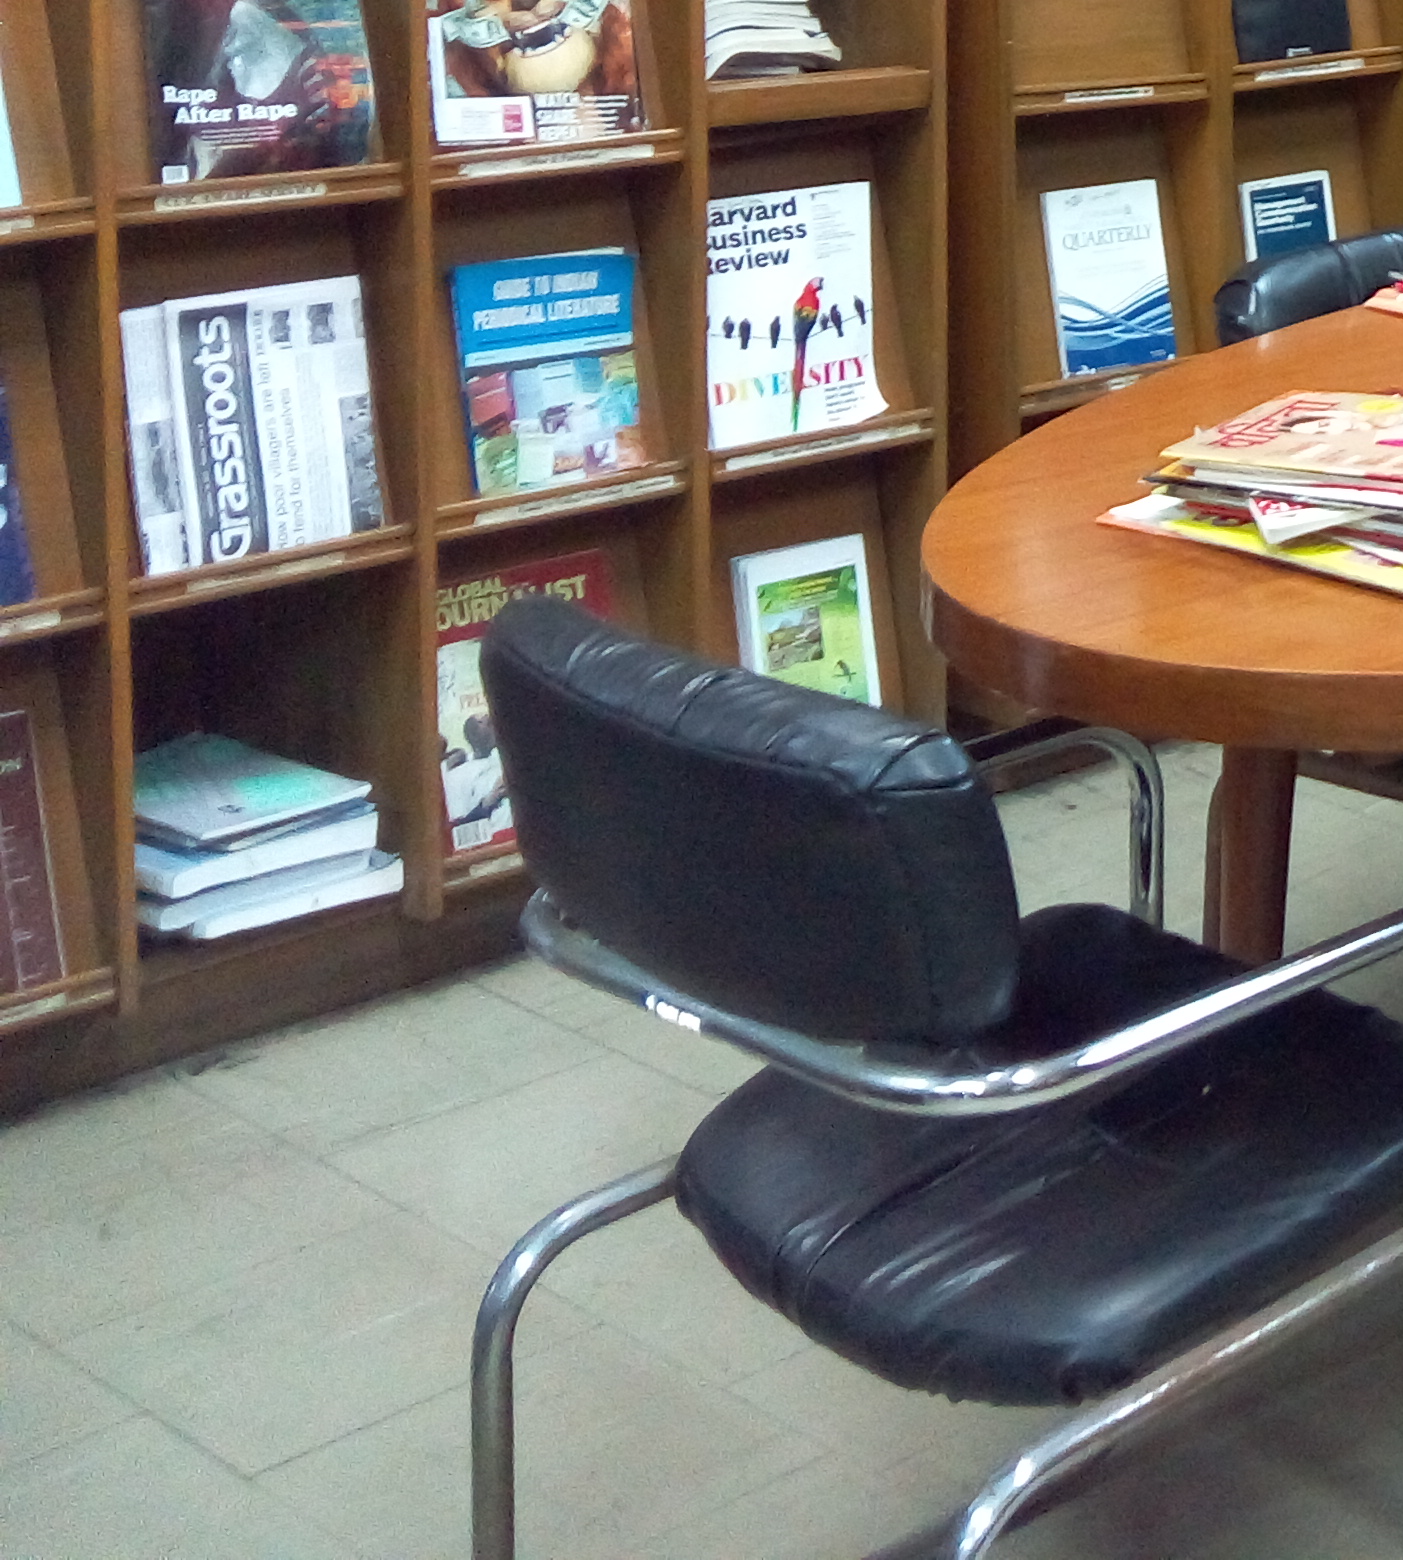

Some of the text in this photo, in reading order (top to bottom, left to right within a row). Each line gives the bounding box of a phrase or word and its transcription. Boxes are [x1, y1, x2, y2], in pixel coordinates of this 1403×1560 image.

[162, 85, 218, 105] Rape
[173, 101, 298, 125] After Rape
[708, 195, 797, 227] arvard
[707, 223, 808, 251] usiness
[1061, 223, 1153, 251] QUARTERLY
[193, 314, 253, 562] Grassroots
[265, 416, 284, 479] villagers
[274, 483, 291, 518] poor
